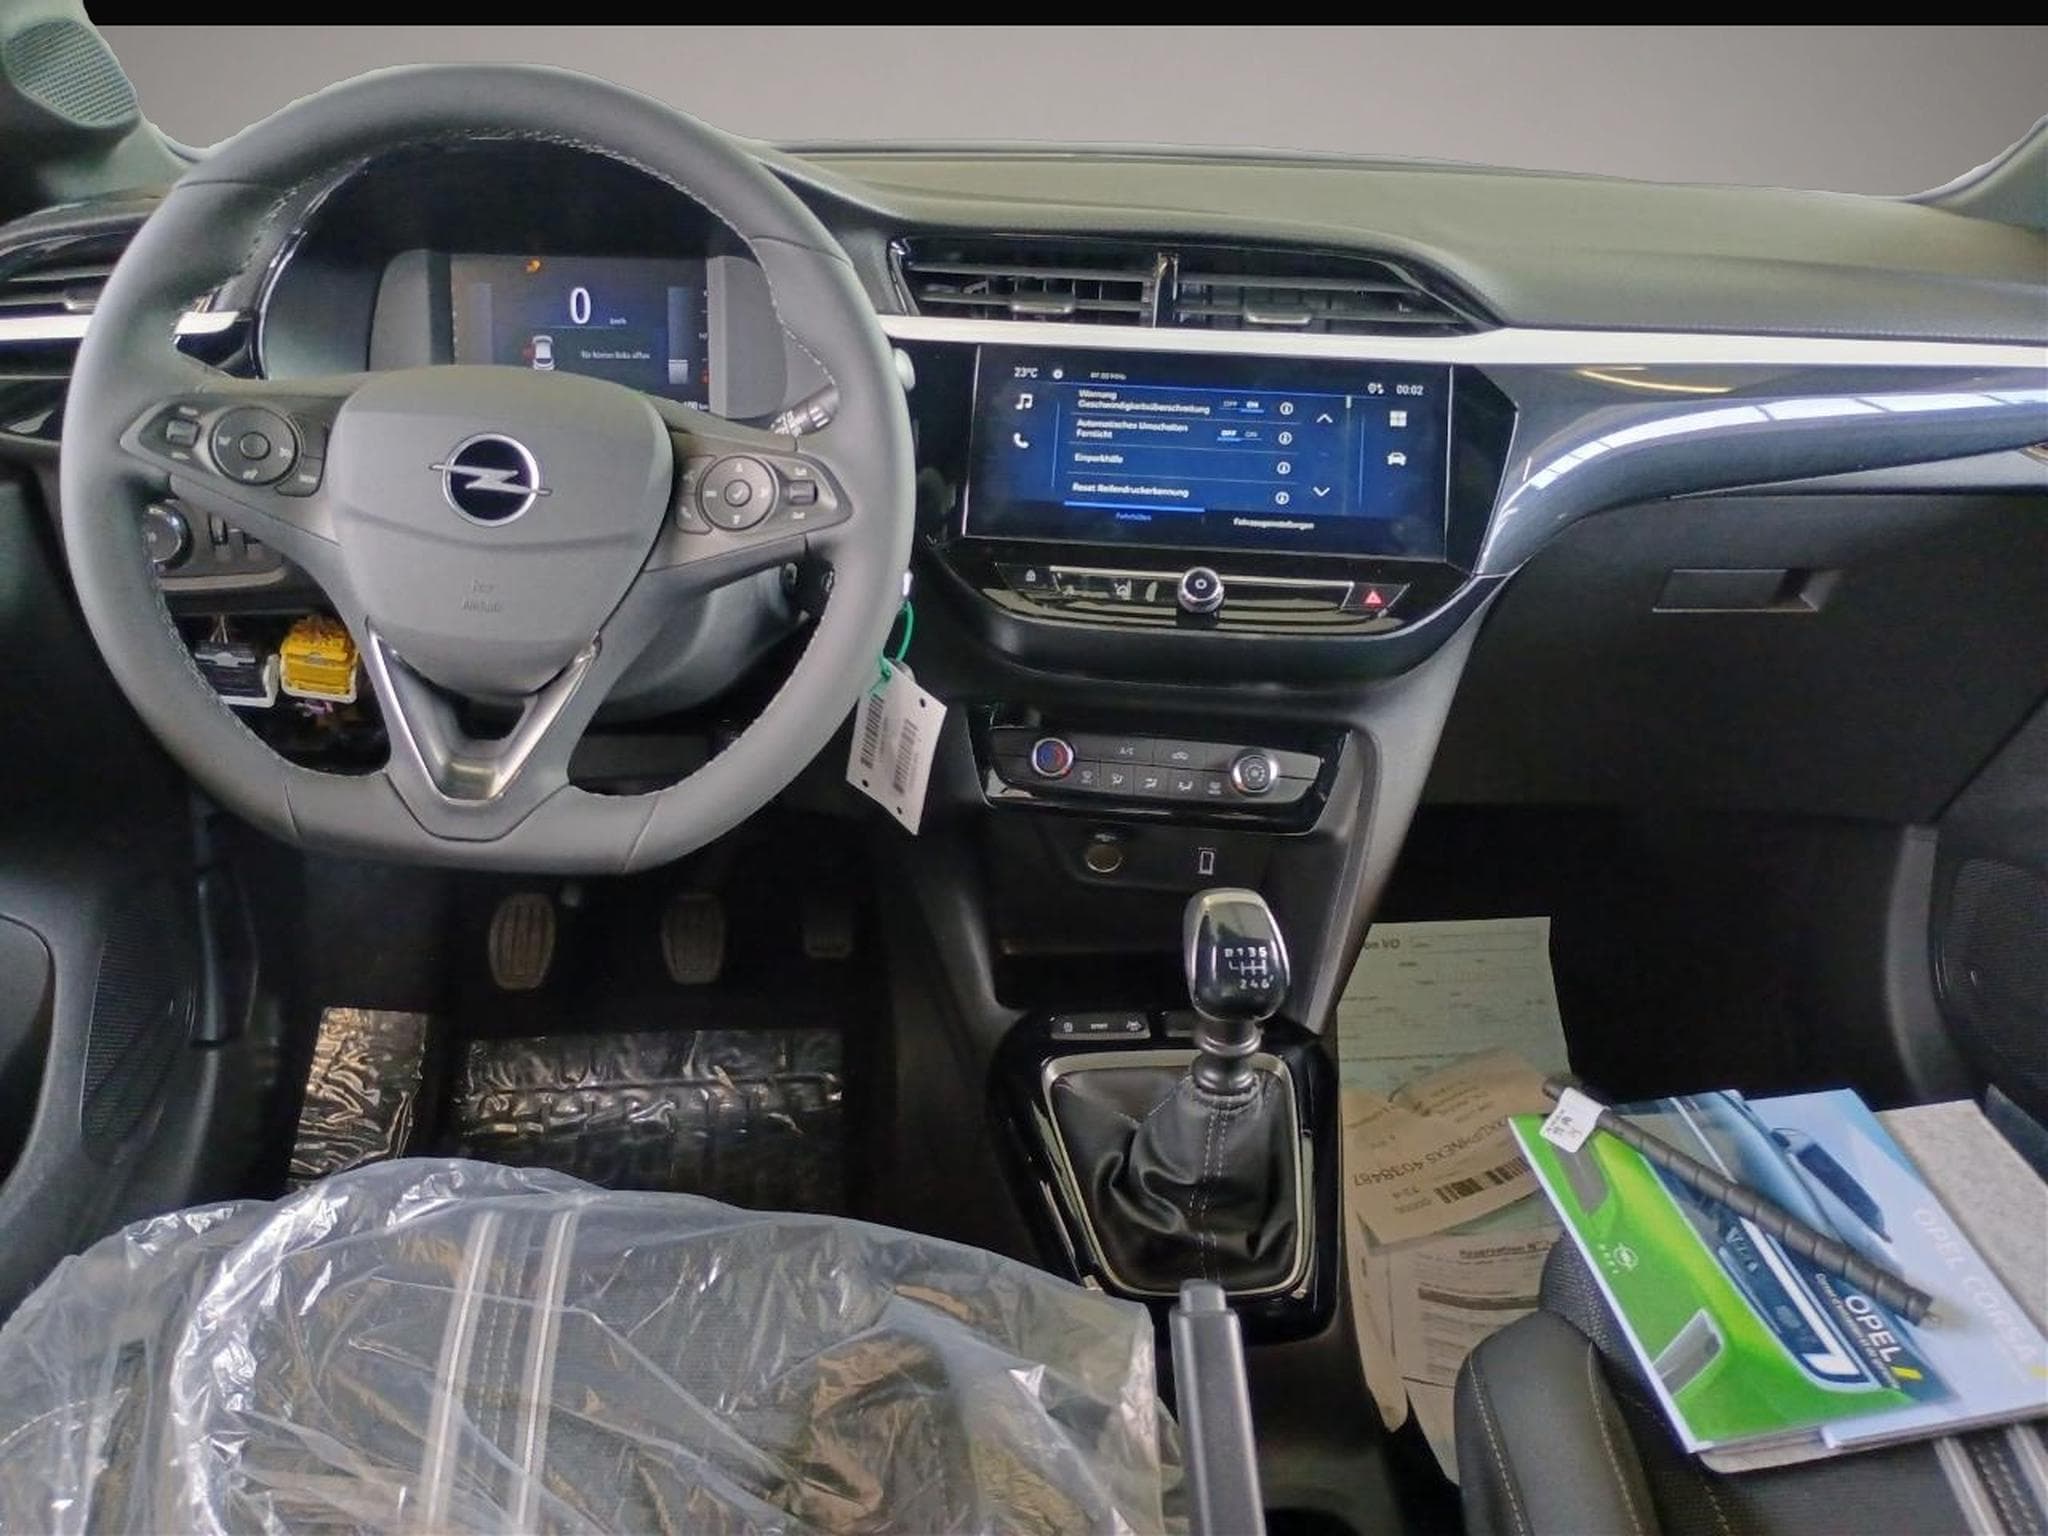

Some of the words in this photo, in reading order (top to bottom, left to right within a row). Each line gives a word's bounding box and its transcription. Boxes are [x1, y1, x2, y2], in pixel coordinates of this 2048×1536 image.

[569, 287, 592, 325] 0
[1014, 366, 1039, 379] 23°C
[1396, 384, 1424, 396] 00:02
[1072, 482, 1096, 493] Reset
[1248, 946, 1256, 957] 3
[1258, 946, 1267, 958] 5
[1239, 979, 1247, 989] 2
[1251, 979, 1259, 989] 4
[1261, 979, 1270, 989] 6
[1913, 1207, 1967, 1272] OPEL
[1845, 1295, 1901, 1363] OPEL
